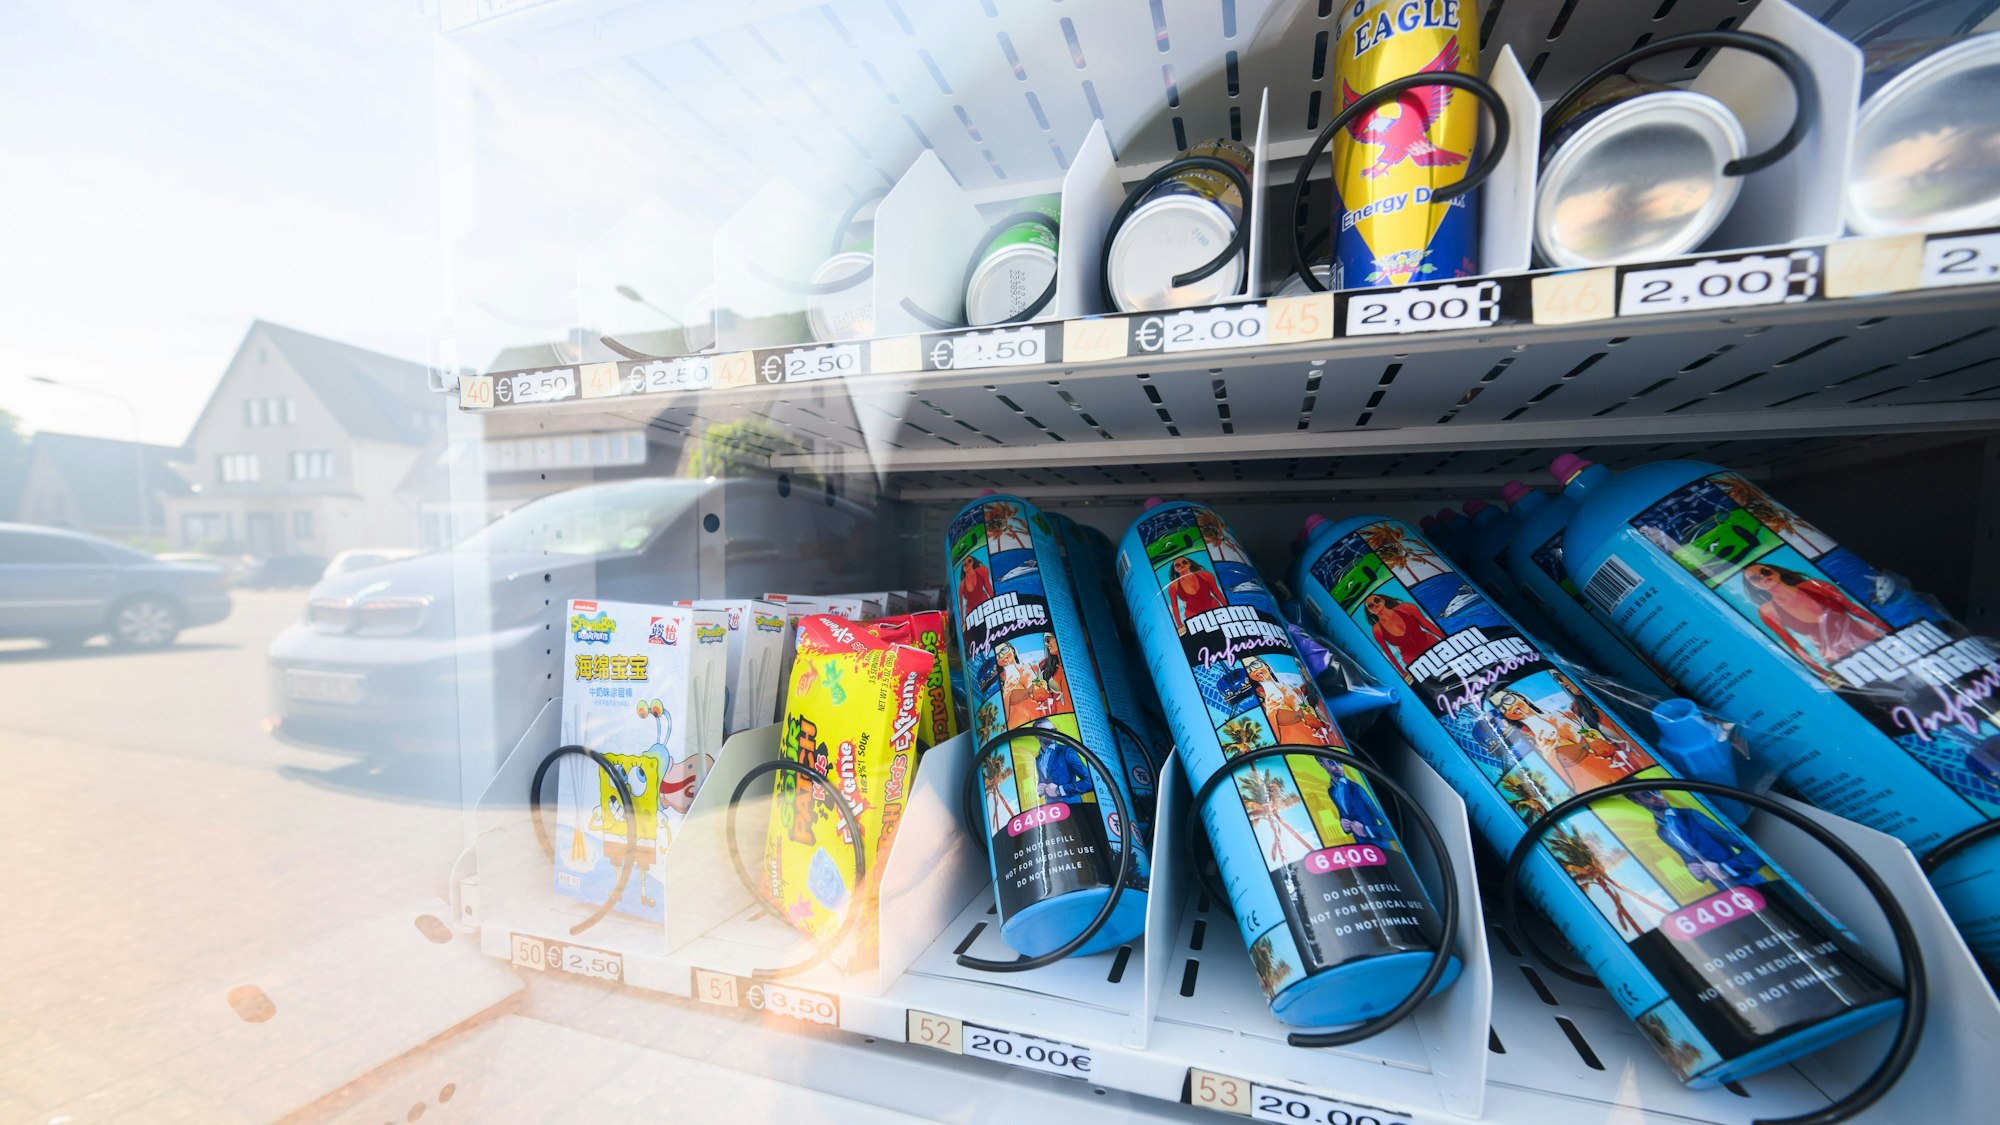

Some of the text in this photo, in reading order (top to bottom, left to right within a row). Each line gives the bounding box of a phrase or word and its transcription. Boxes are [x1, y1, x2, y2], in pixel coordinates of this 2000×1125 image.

[1353, 0, 1461, 60] EAGLE
[1342, 192, 1408, 232] Energy
[1545, 284, 1599, 314] 46
[1640, 270, 1772, 304] 2,00
[1273, 303, 1320, 335] 45
[1361, 297, 1469, 326] 2,00
[1074, 329, 1114, 357] 44
[1136, 317, 1261, 351] € 2.00
[761, 352, 855, 382] € 2.50
[930, 339, 1038, 370] € 2.50
[589, 369, 614, 391] 41
[627, 363, 708, 391] € 2.50
[719, 357, 749, 384] 42
[467, 383, 490, 404] 40
[496, 374, 569, 402] € 2.50
[1635, 586, 1659, 607] E942
[968, 616, 1049, 660] Infusions
[574, 653, 649, 682] 海绵宝宝
[1197, 637, 1293, 671] Infusions
[881, 678, 890, 688] 3.5
[884, 668, 892, 677] OZ
[1436, 650, 1541, 721] Infusions
[877, 700, 886, 713] NET
[879, 689, 888, 700] WT
[857, 731, 871, 760] SOUR
[812, 753, 829, 802] Kds
[885, 753, 908, 802] Kids
[1013, 806, 1062, 833] 640G
[1014, 834, 1075, 860] DO NOT REFILL
[1314, 847, 1378, 870] 640G
[1005, 846, 1095, 880] NOT FOR MEDICAL USE
[1016, 861, 1083, 888] DO NOT INHALE
[1323, 883, 1401, 902] DO NOT REFILL
[1309, 898, 1424, 925] NOT FOR MEDICAL USE
[1674, 891, 1755, 935] 640G
[1335, 916, 1420, 937] DO NOT INHALE
[519, 943, 541, 964] 50
[546, 946, 620, 976] € 2,50
[1703, 929, 1801, 974] DO NOT REFILL
[1697, 941, 1838, 1004] NOT FOR MEDICAL USE
[710, 978, 733, 1001] 51
[746, 985, 834, 1018] € 3,50
[1736, 965, 1843, 1013] DO NOT INHALE
[919, 1018, 952, 1046] 52
[971, 1034, 1092, 1072] 20.00€
[1200, 1075, 1238, 1107] 53
